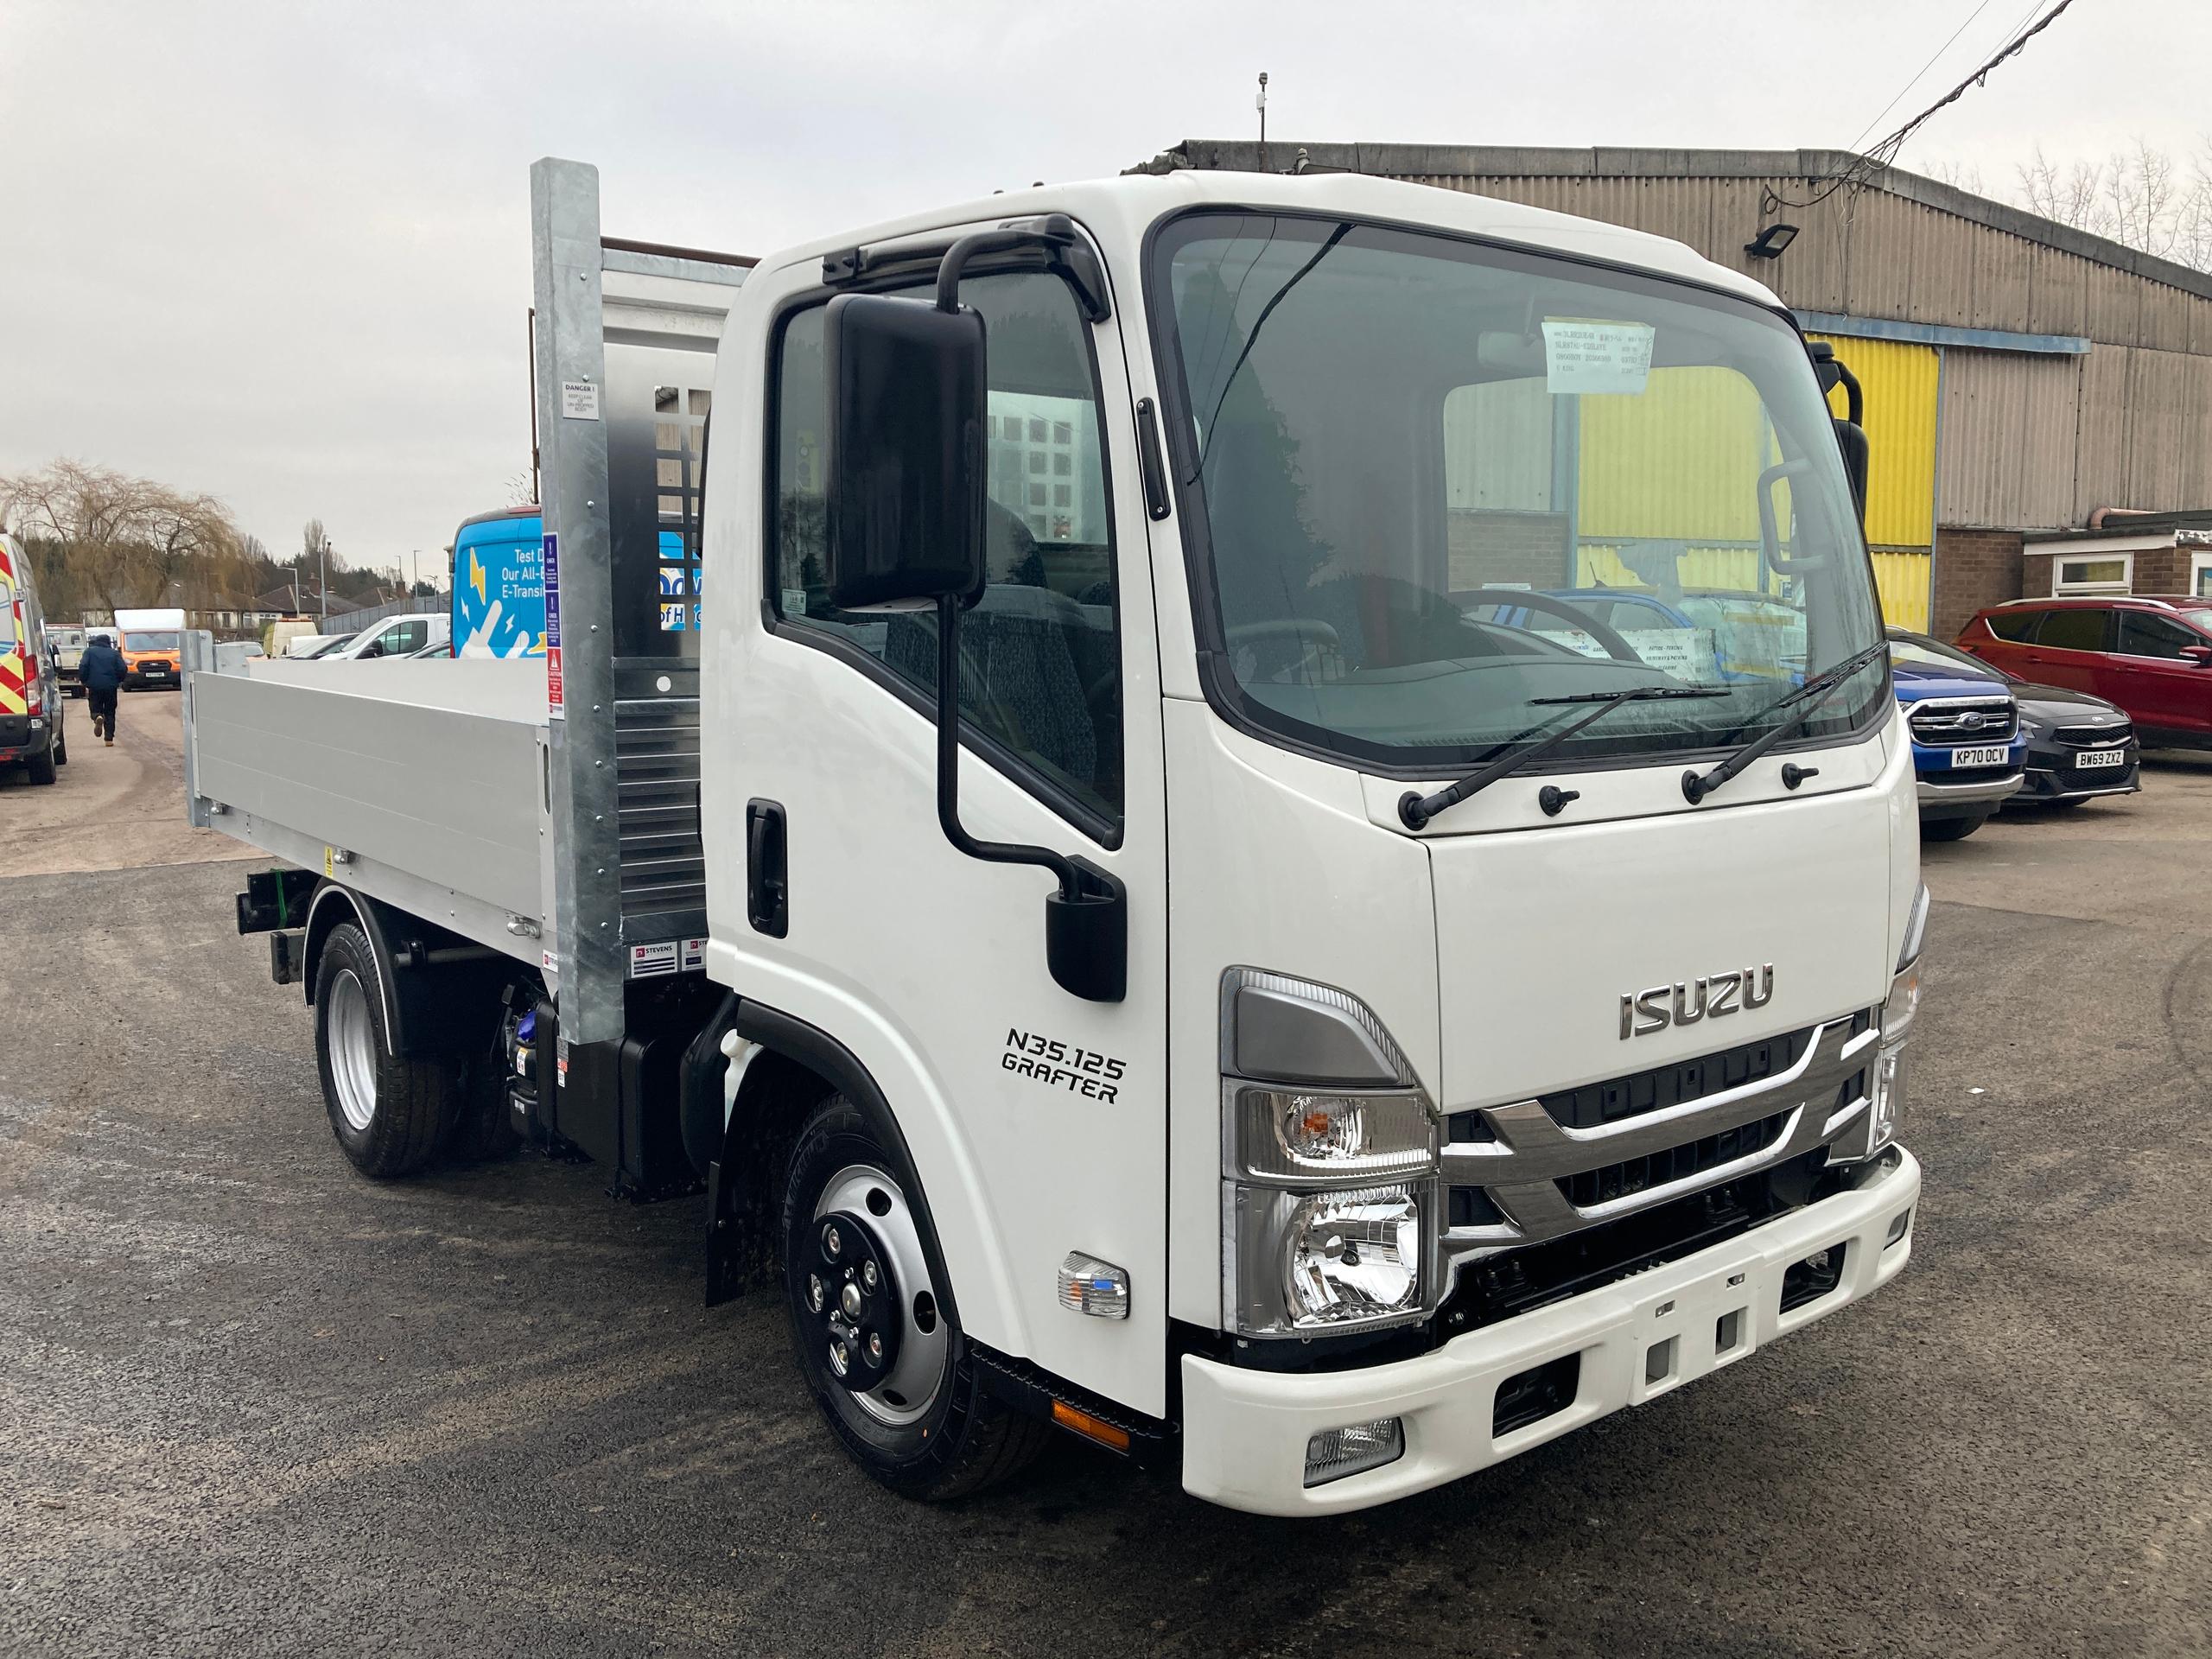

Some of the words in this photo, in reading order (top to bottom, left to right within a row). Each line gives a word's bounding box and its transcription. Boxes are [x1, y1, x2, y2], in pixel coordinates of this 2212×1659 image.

[515, 549, 535, 563] Test
[501, 567, 519, 581] Our
[1956, 748, 1984, 764] KP70
[1986, 747, 2005, 762] OCV
[2080, 753, 2104, 766] BW69
[2105, 752, 2121, 764] ZXZ
[645, 945, 672, 954] STEVENS
[1619, 962, 1774, 1040] ISUZU
[1006, 1027, 1127, 1081] N35.125
[1001, 1052, 1118, 1105] GRAFTER
